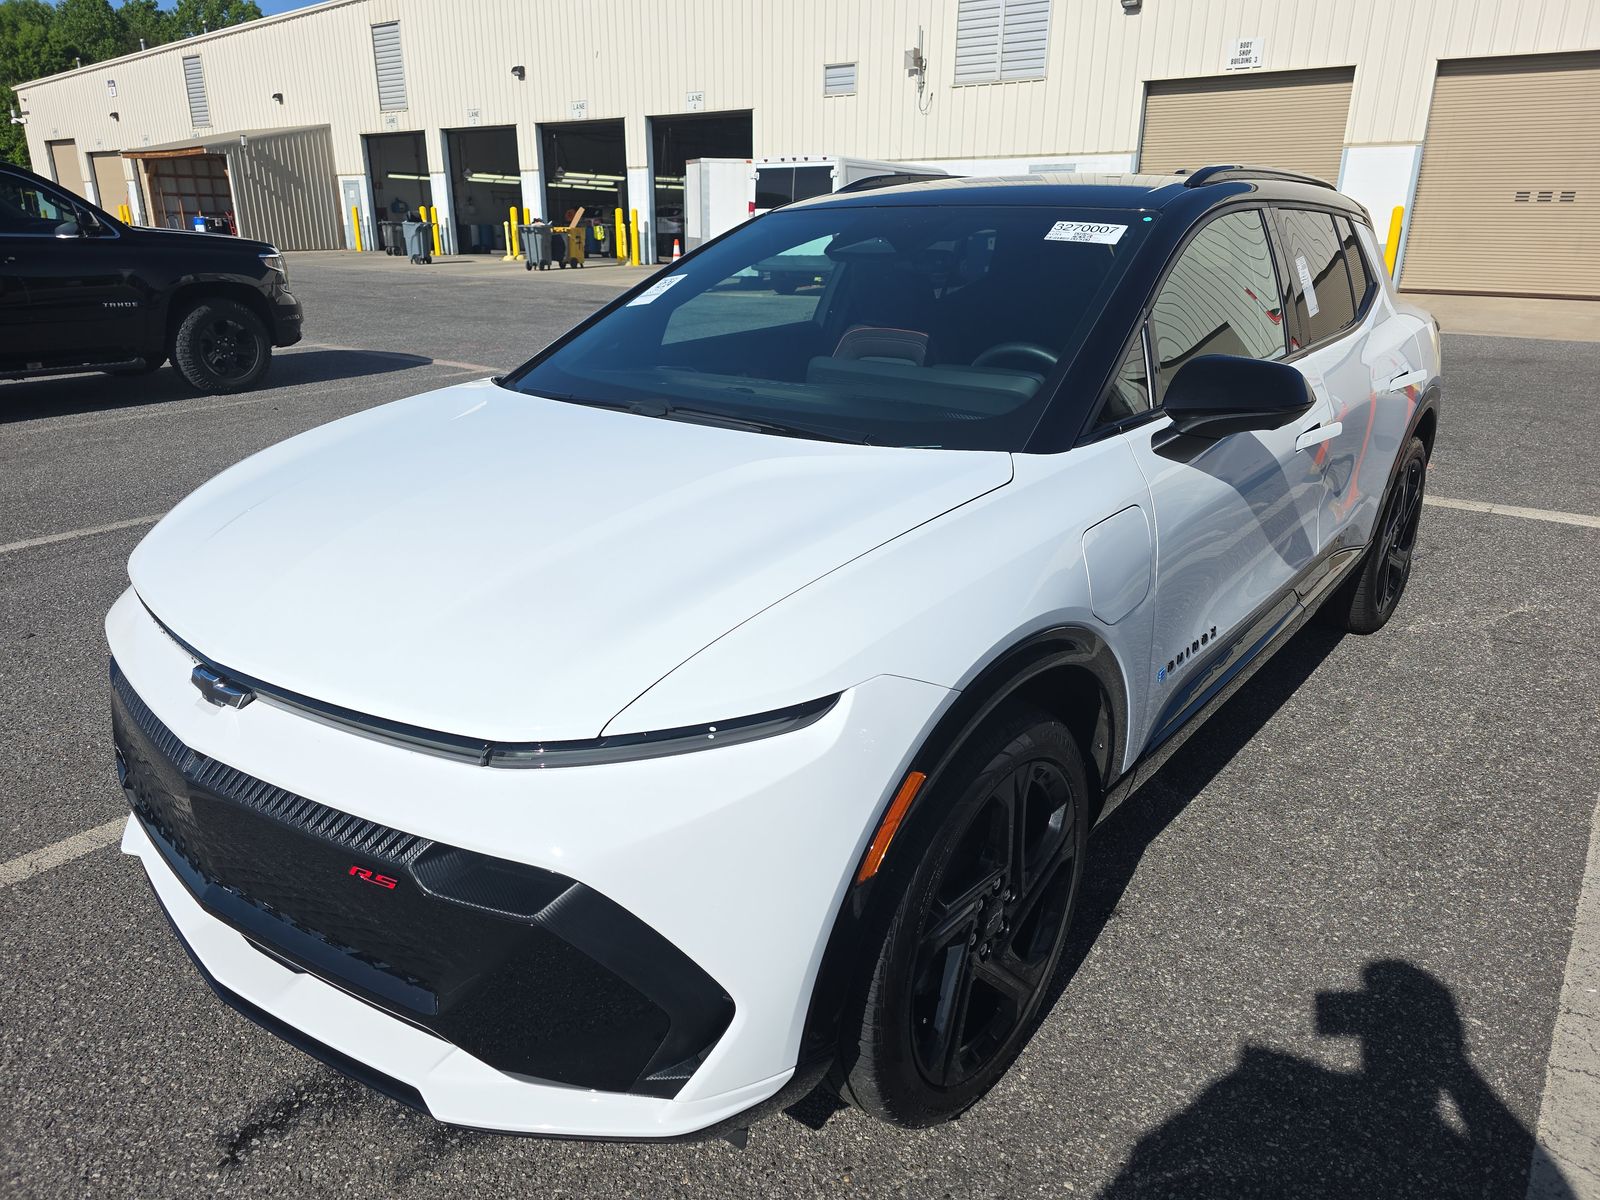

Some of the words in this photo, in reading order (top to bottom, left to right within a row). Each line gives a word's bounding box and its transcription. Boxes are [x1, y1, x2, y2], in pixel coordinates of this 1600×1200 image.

[1240, 41, 1253, 49] BODY
[1239, 49, 1252, 57] SHOP
[1230, 56, 1252, 65] BUILDING
[687, 94, 702, 102] LANE
[572, 102, 585, 110] LANE
[1054, 223, 1120, 234] 3270007
[1157, 625, 1217, 683] EQUINOX
[349, 865, 398, 889] RS
